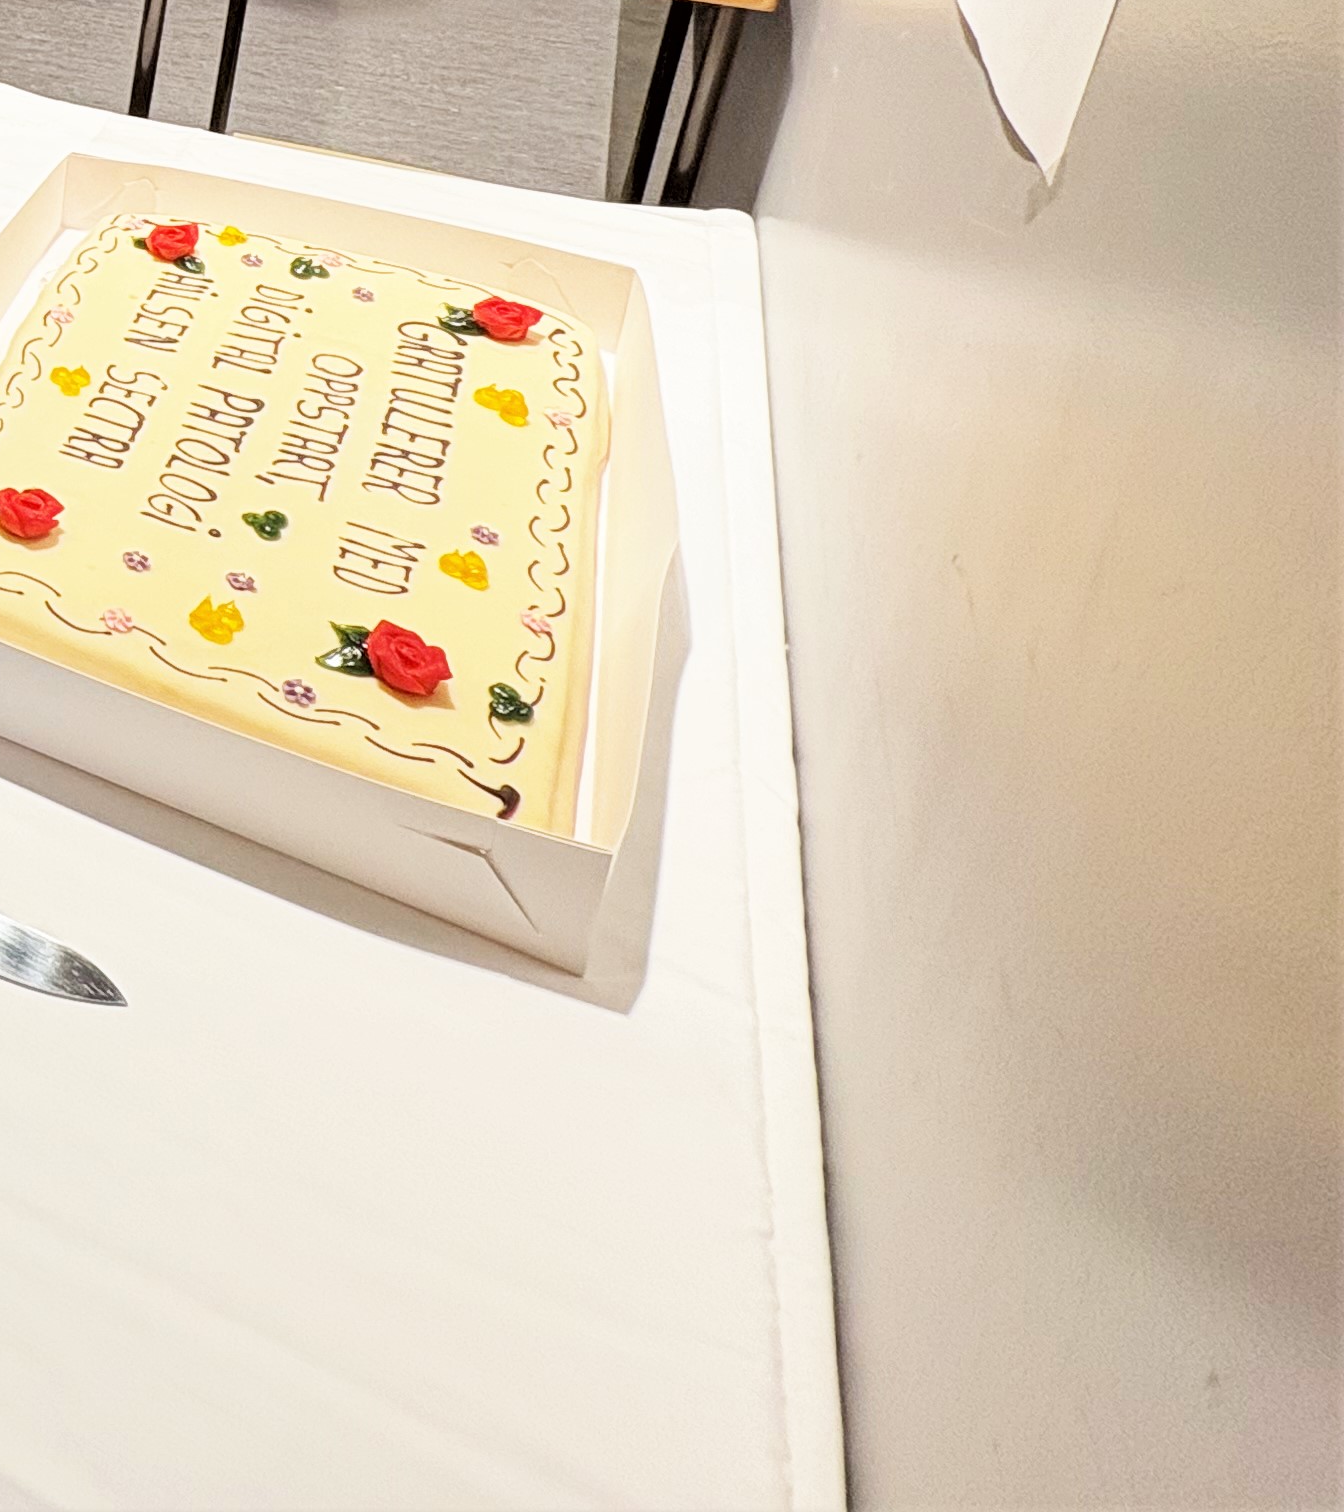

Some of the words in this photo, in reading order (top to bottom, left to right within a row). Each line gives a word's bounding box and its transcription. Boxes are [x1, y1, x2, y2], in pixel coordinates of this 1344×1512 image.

[59, 363, 169, 471] SECTRA
[255, 353, 365, 503] OPPSTART,
[360, 320, 469, 507] GRATULERER
[332, 521, 428, 596] MED
